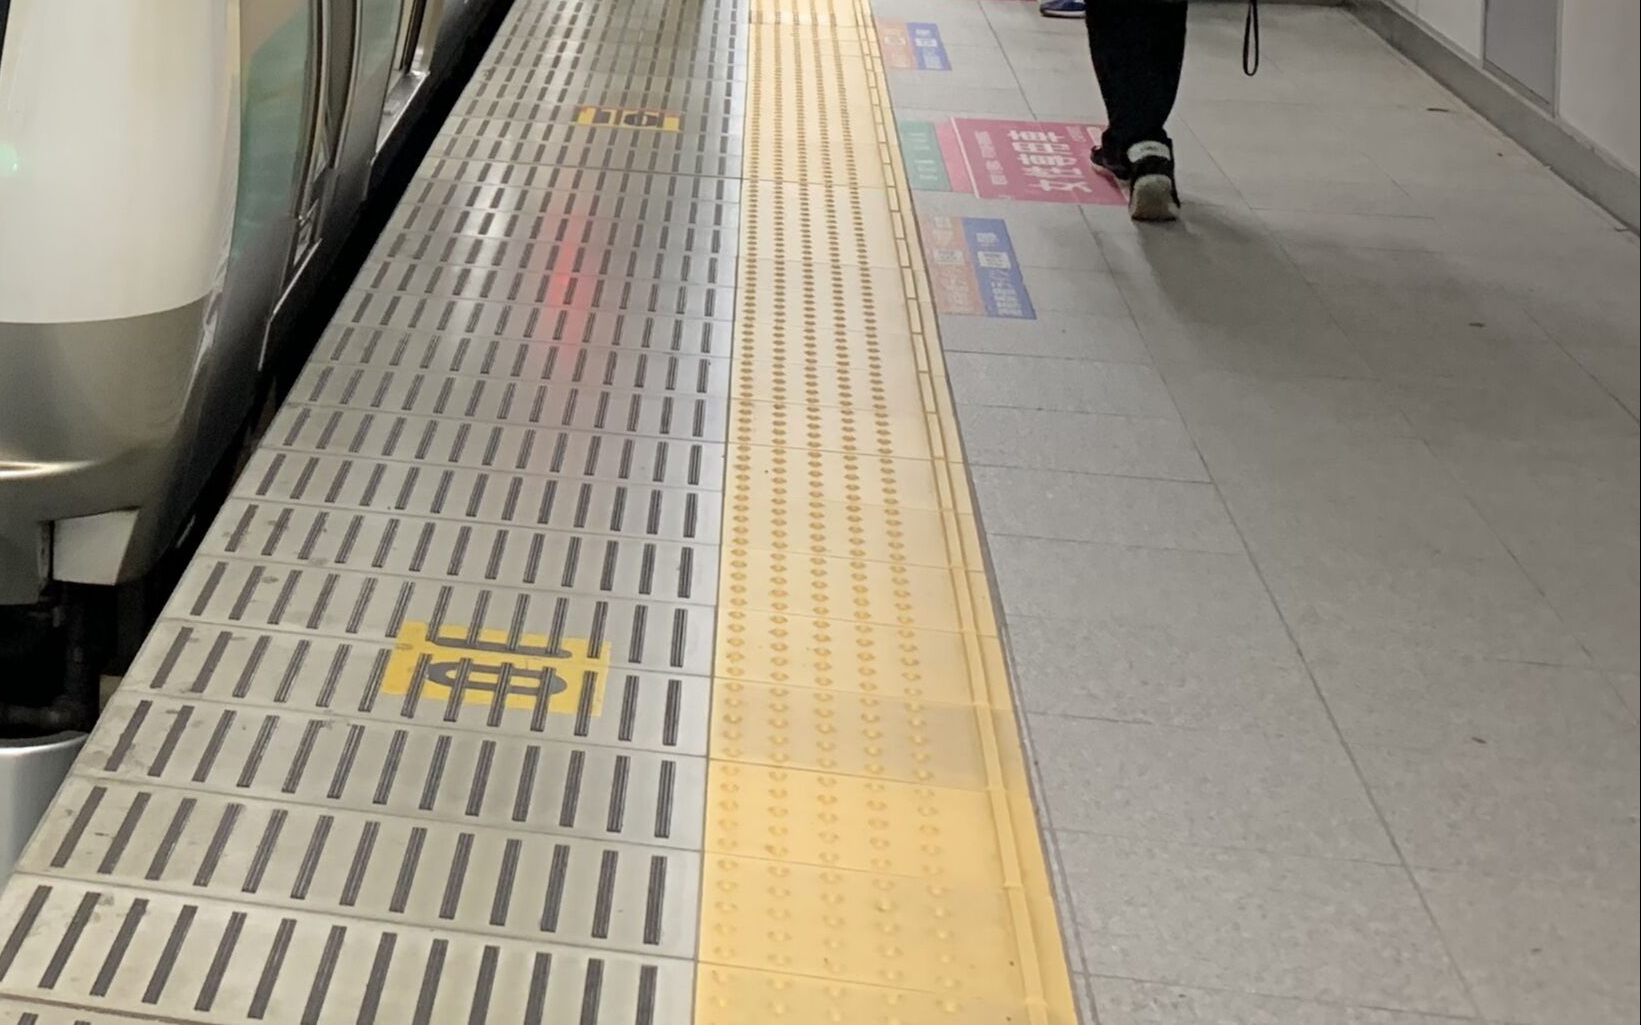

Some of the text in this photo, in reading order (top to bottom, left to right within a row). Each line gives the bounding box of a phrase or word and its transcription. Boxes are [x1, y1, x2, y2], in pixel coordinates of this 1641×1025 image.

[1008, 129, 1094, 194] 女性専用車
